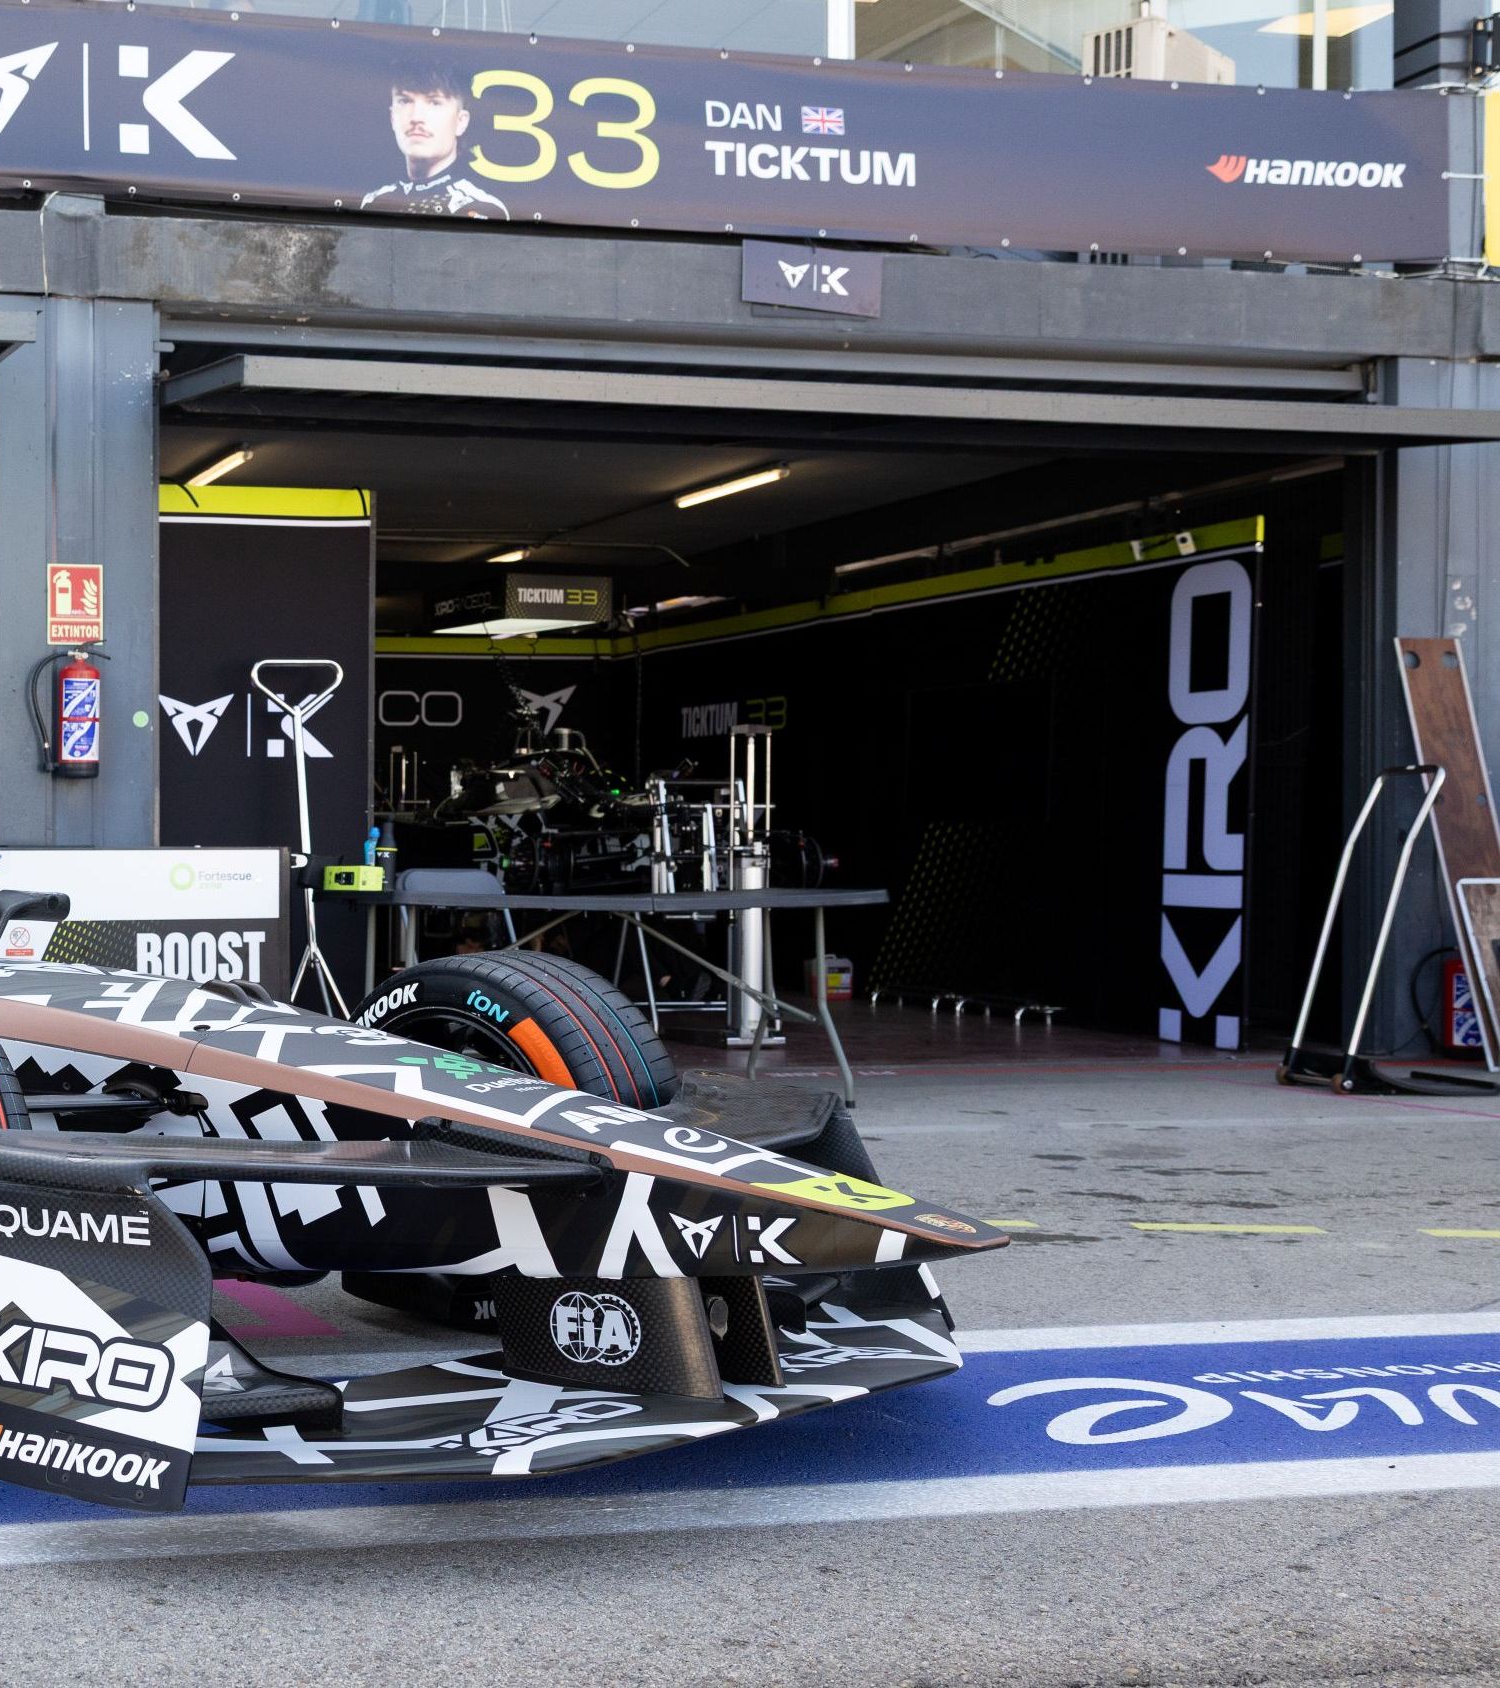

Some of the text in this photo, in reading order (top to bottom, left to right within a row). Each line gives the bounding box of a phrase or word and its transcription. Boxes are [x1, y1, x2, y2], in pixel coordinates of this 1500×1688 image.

[469, 70, 660, 189] 33
[705, 101, 783, 131] DAN
[705, 141, 917, 187] TICKTUM
[517, 587, 599, 606] TICKTUM 33
[51, 624, 99, 638] EXTINTOR
[681, 702, 738, 739] TICKTUM
[1159, 560, 1252, 1050] KIRO
[198, 871, 252, 881] Fortescue
[137, 931, 266, 983] BOOST
[437, 1401, 643, 1456] KIRO
